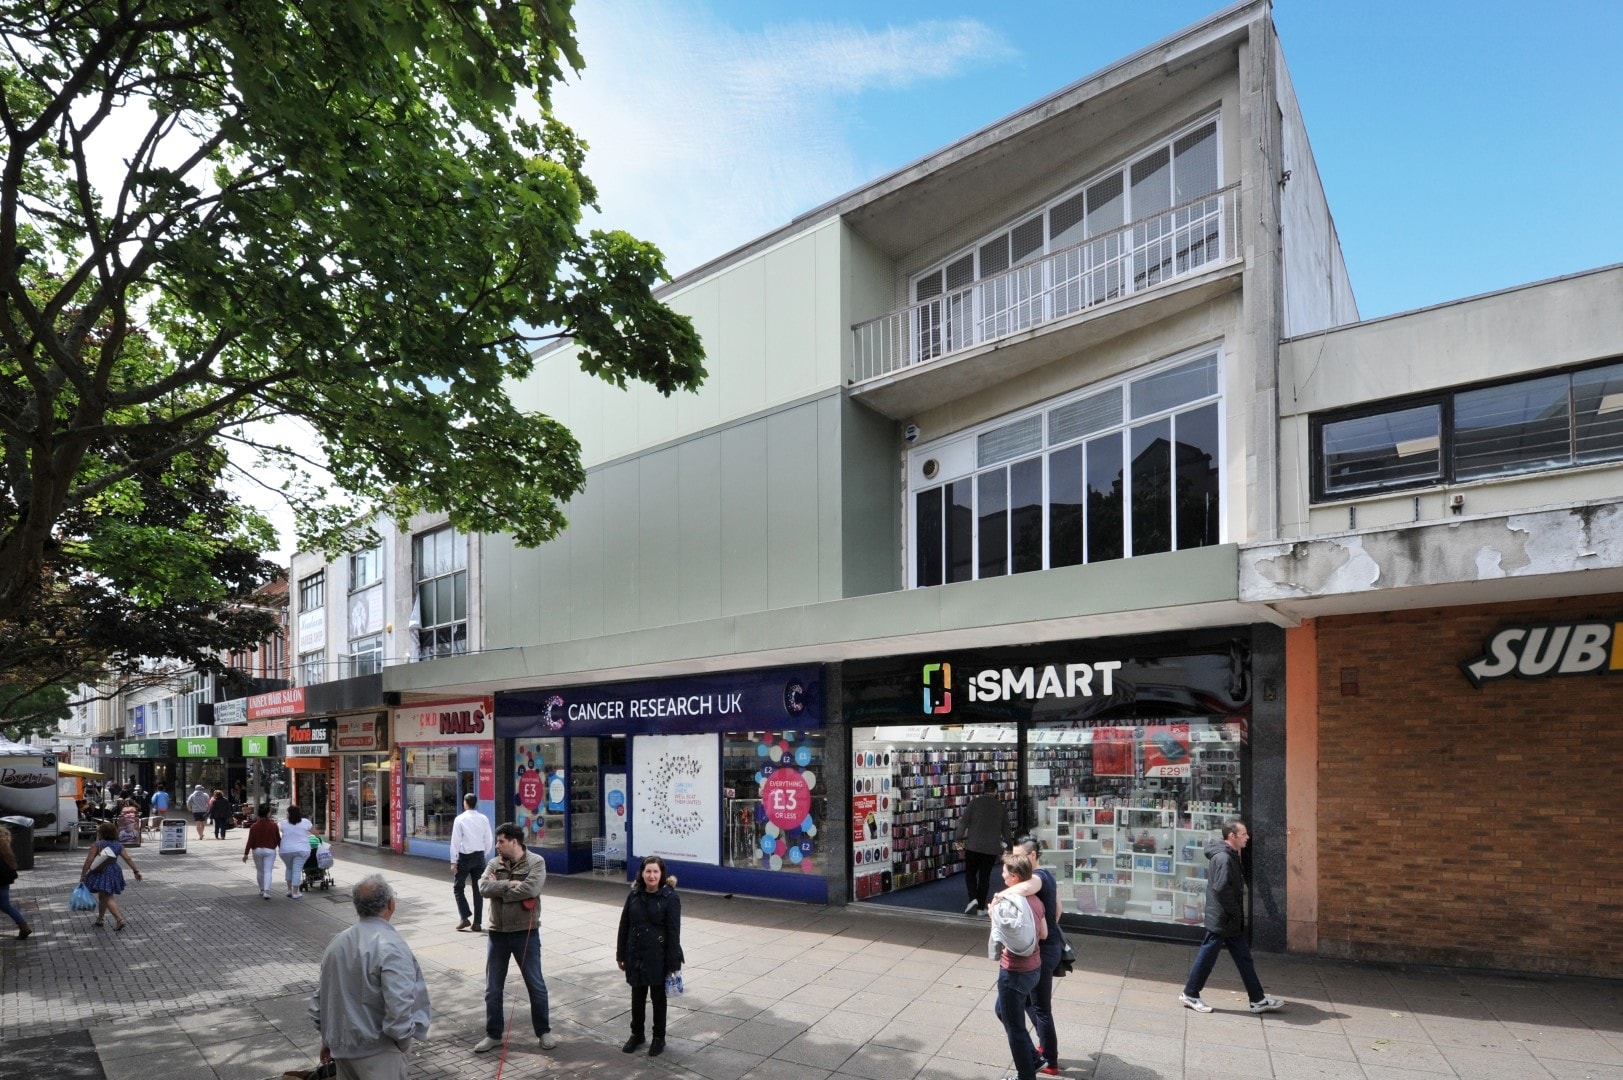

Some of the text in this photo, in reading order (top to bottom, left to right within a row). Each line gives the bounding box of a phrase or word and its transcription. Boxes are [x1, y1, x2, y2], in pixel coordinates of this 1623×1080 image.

[968, 661, 1121, 701] iSMART
[268, 692, 281, 705] HAIR
[282, 688, 302, 703] SALON
[568, 702, 624, 721] CANCER
[630, 695, 712, 718] RESEARCH
[718, 693, 742, 713] UK
[439, 709, 485, 734] NAILS
[290, 726, 312, 742] Phone
[312, 728, 326, 740] BOSS
[188, 742, 206, 754] lime
[248, 740, 260, 754] lime
[524, 784, 536, 798] £3
[773, 789, 797, 810] £3
